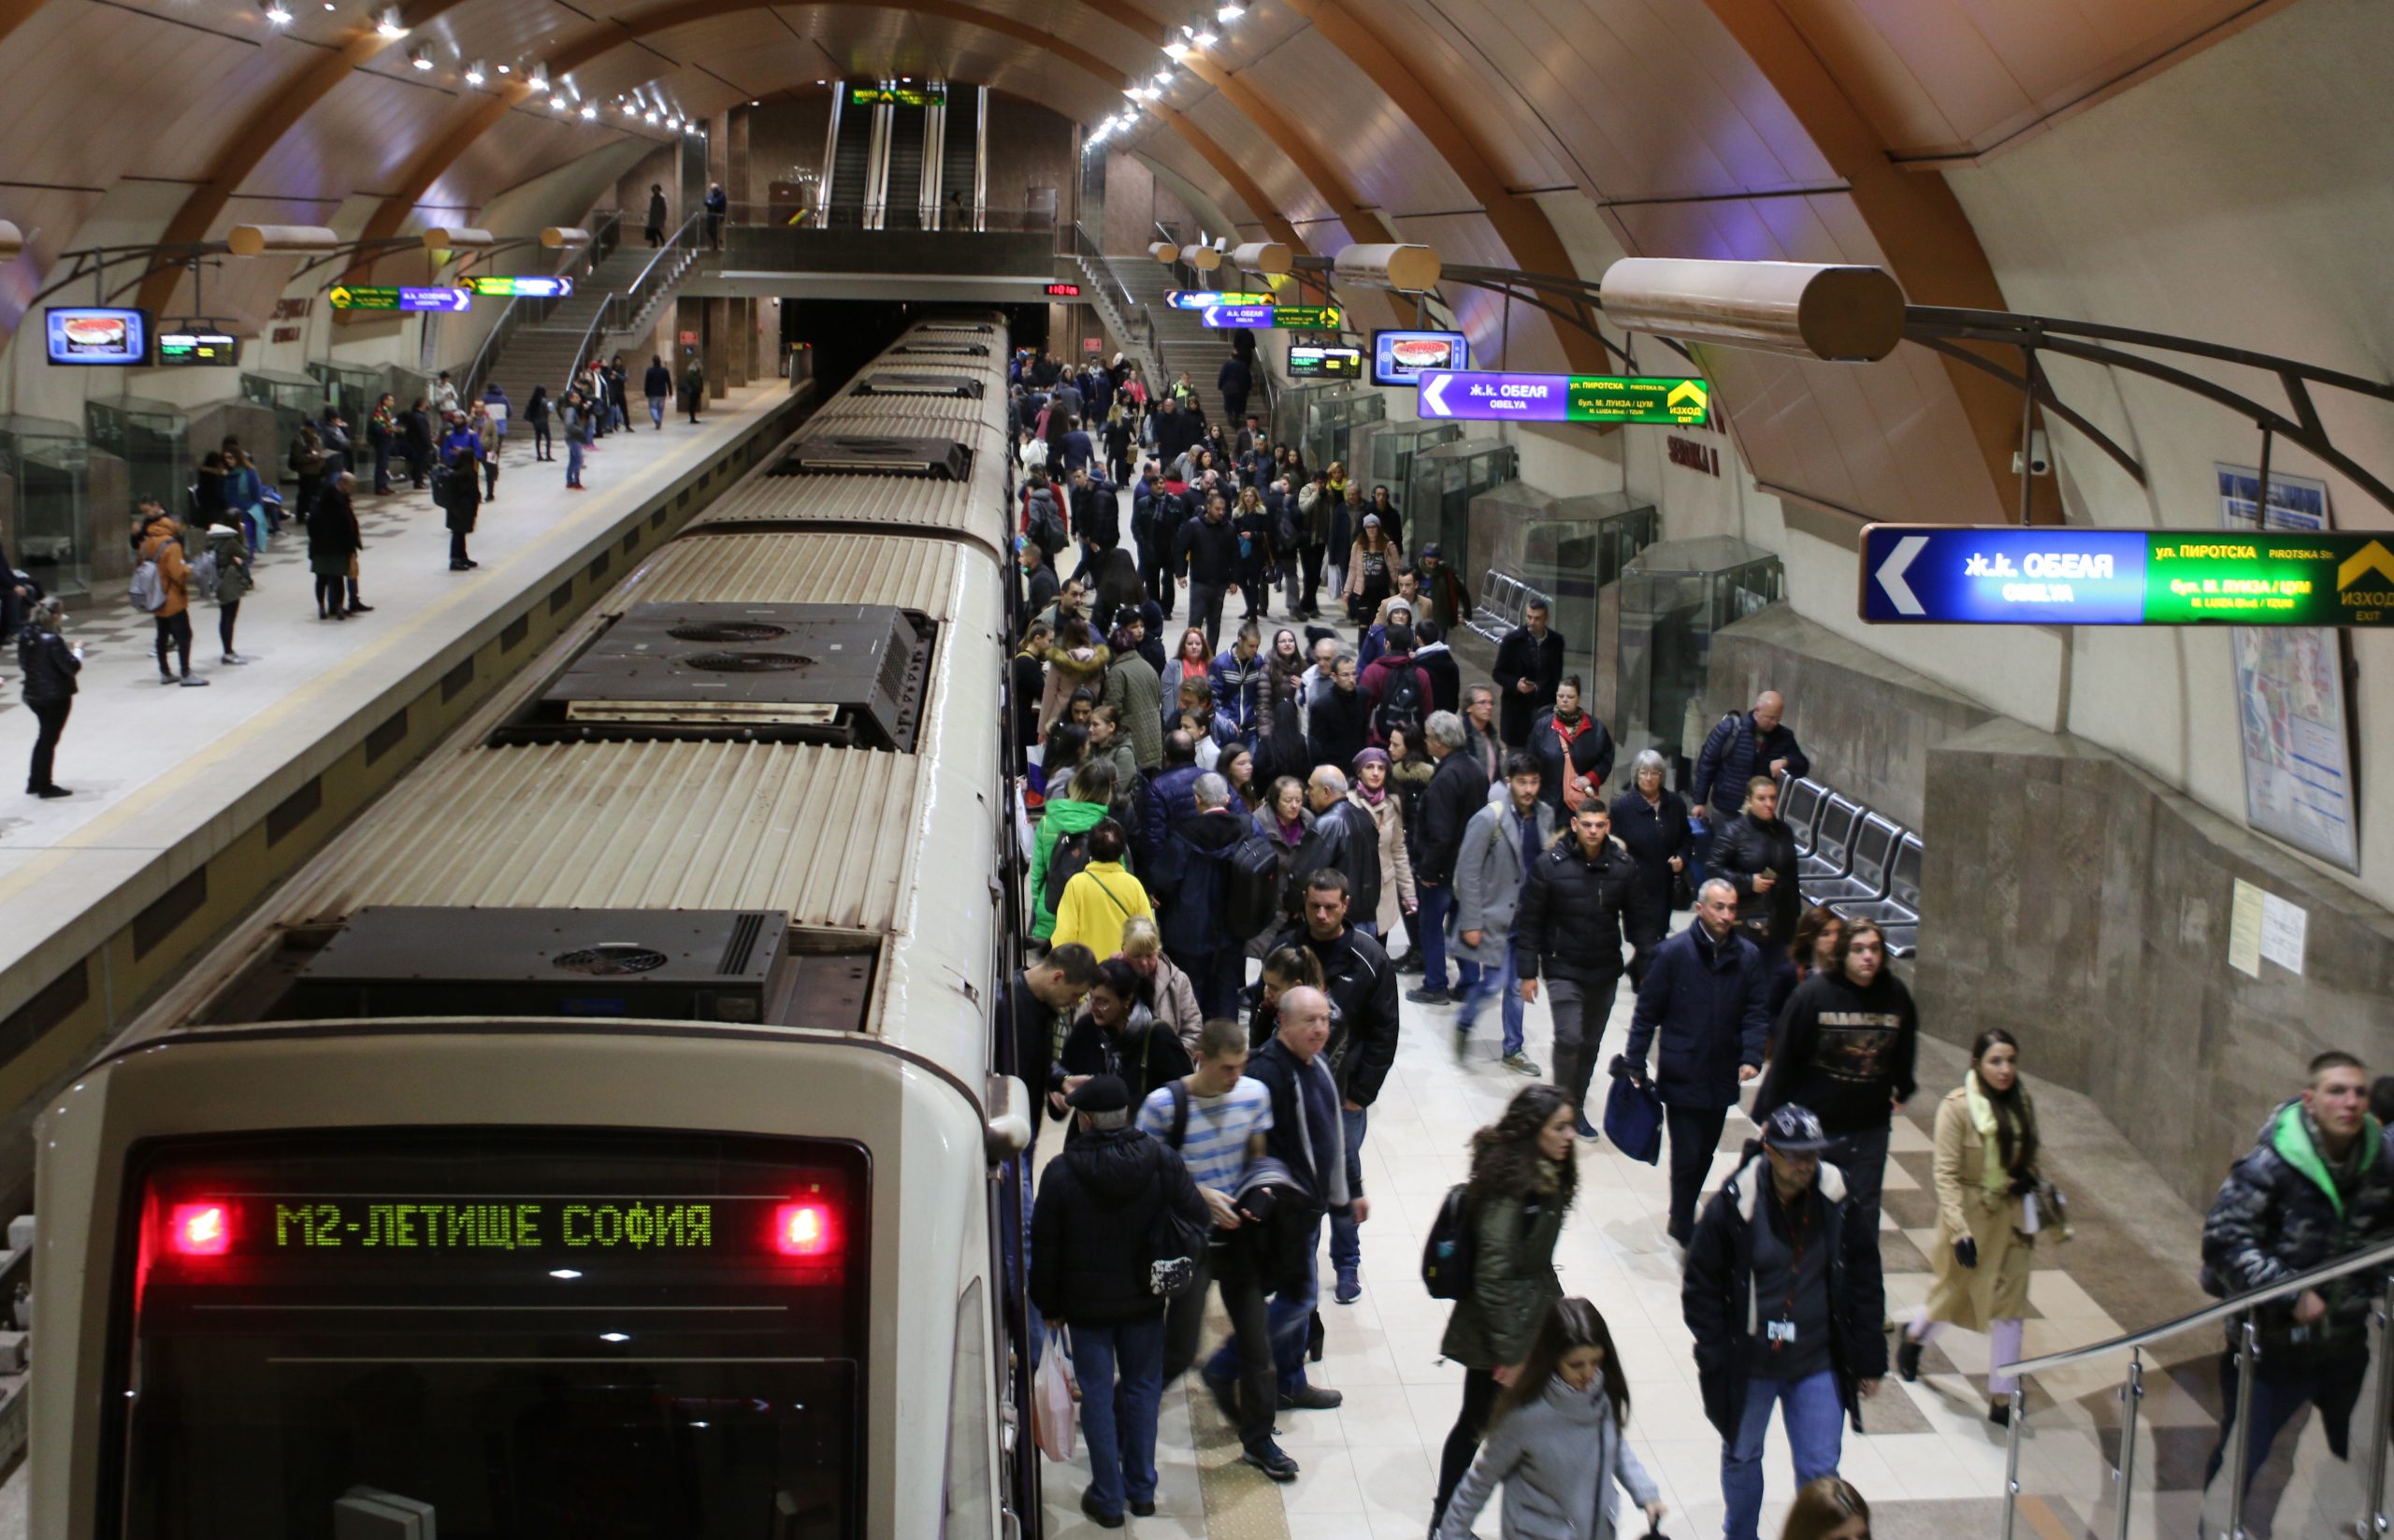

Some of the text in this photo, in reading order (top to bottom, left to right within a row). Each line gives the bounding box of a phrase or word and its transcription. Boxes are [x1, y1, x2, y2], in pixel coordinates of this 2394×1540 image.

[1500, 383, 1548, 398] ОБЕЛЯ
[1582, 381, 1623, 391] ПИРОТСКА
[1490, 399, 1526, 410] OBELYA
[1605, 399, 1632, 408] ЛУИЗА
[1636, 400, 1653, 409] ЦУМ
[1669, 407, 1702, 416] ИЗХОД
[2156, 544, 2257, 561] ул. ПИРОТСКА
[2269, 549, 2318, 559] PIROTSKA
[2024, 553, 2113, 579] ОБЕЛЯ
[2222, 579, 2271, 594] ЛУИЗА
[2280, 580, 2312, 596] ЦУМ
[2356, 611, 2381, 621] EXIT
[276, 1202, 712, 1249] М2-ЛЕТИЩЕ СОФИЯ
